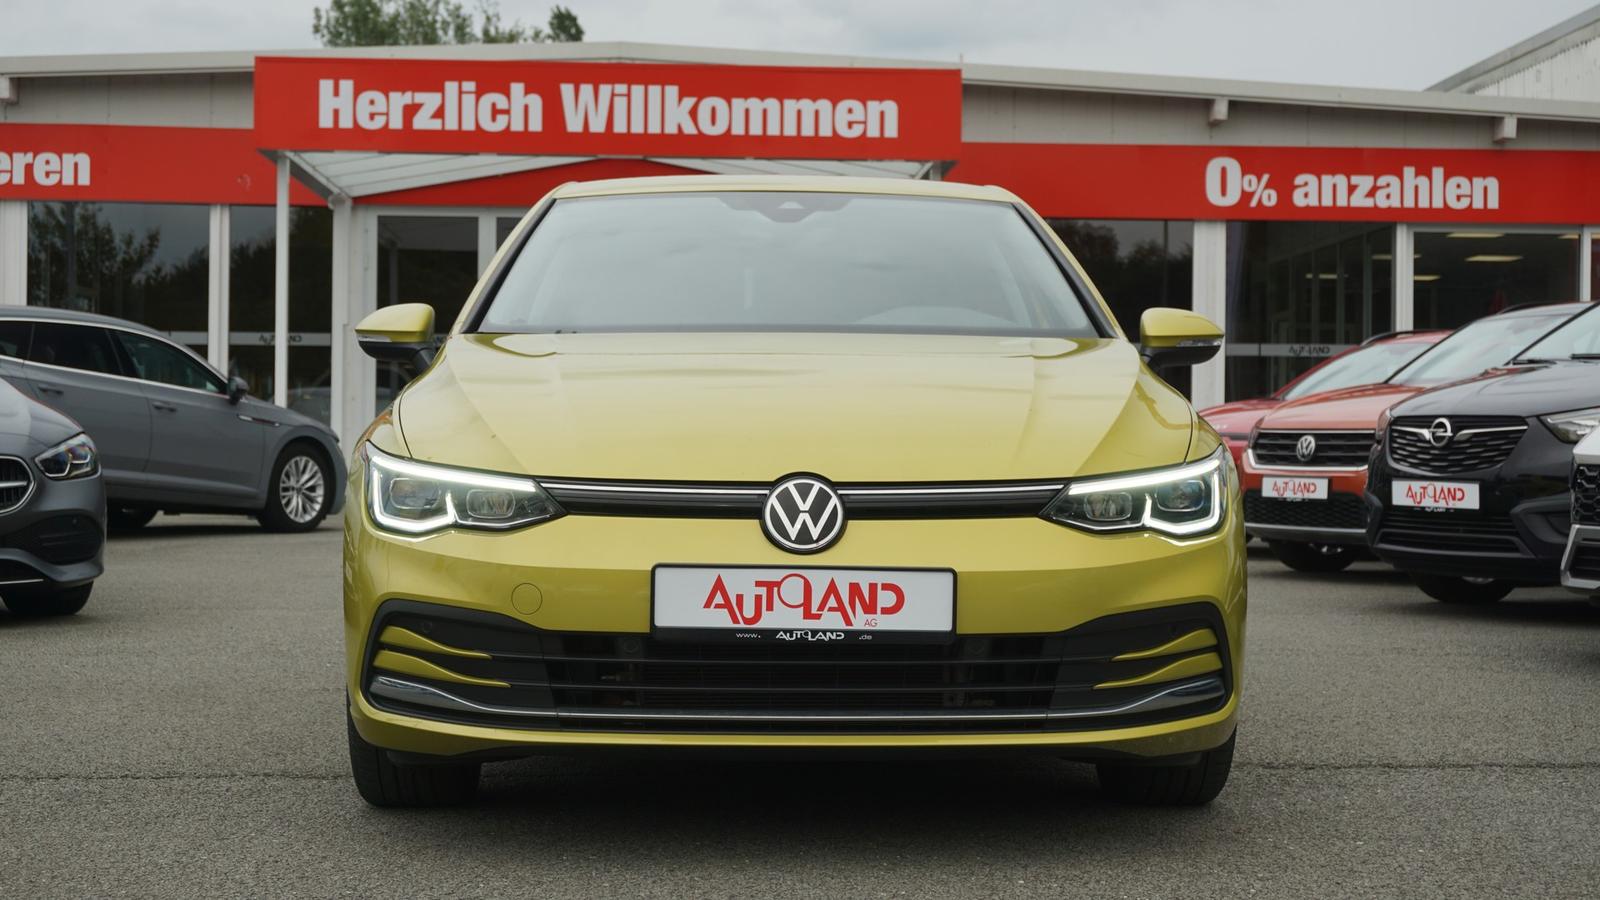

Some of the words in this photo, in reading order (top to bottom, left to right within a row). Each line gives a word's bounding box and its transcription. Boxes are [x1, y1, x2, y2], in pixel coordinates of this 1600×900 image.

[318, 79, 543, 133] Herzlich
[559, 83, 899, 138] Willkommen
[1205, 156, 1278, 208] 0%
[1293, 166, 1500, 210] anzahlen
[1272, 480, 1317, 497] AUTOLAND
[1405, 482, 1465, 506] AUTOLAND
[766, 478, 842, 547] VW
[702, 573, 906, 628] AUTOLAND
[775, 629, 845, 642] AUTOLAND
[863, 618, 879, 628] AG
